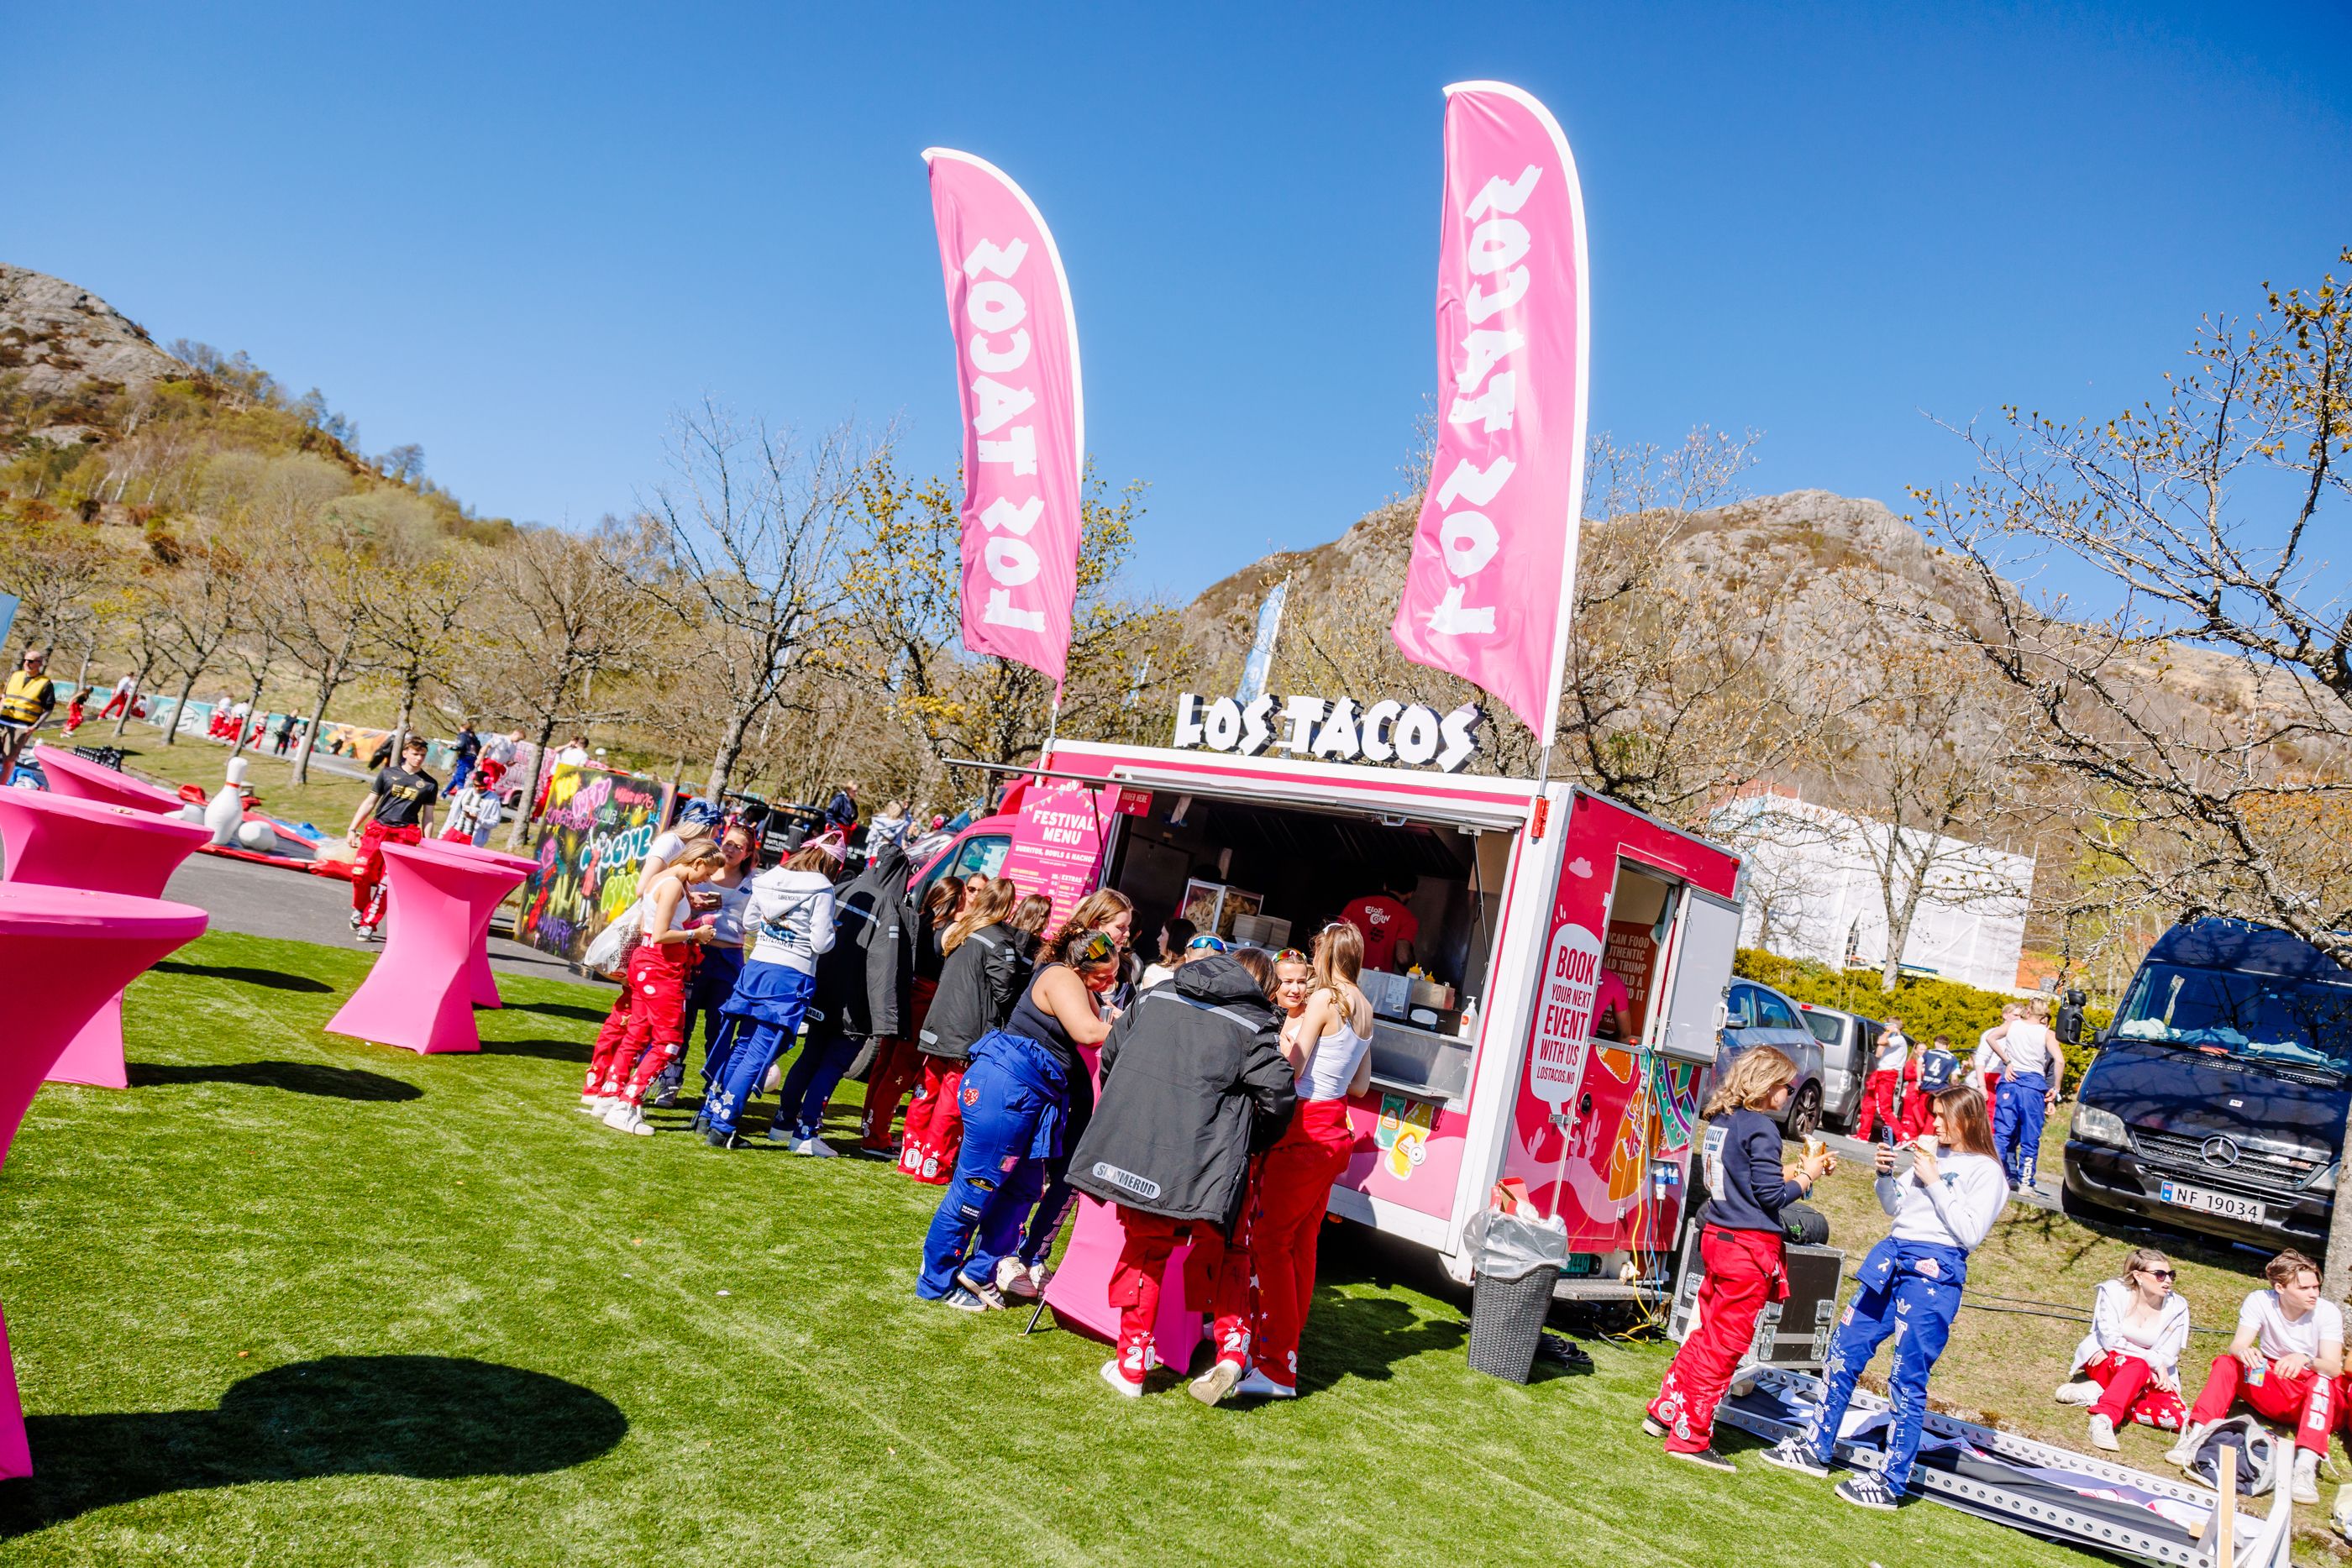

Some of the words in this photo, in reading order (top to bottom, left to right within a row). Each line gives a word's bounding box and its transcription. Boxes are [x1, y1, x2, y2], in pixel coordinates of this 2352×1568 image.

[1174, 691, 1282, 757] LOS
[1287, 695, 1487, 774] TACOS
[1032, 810, 1095, 831] FESTIVAL
[1042, 826, 1082, 845] MENU
[1015, 845, 1044, 856] BURRITOS,
[1044, 849, 1065, 858] BOWLS
[1071, 854, 1096, 863] NACHOS
[1061, 874, 1083, 884] EXTRAS
[1628, 935, 1650, 949] FOOD
[1555, 945, 1598, 986] BOOK
[1619, 959, 1647, 974] TRUMP
[1551, 983, 1572, 1005] YOUR
[1572, 988, 1592, 1009] NEXT
[1635, 989, 1646, 1001] IT
[1543, 1004, 1588, 1041] EVENT
[1539, 1038, 1567, 1064] WITH
[1566, 1043, 1580, 1067] US
[1536, 1066, 1575, 1085] LOSTACOS.NO
[1929, 1057, 1941, 1077] 4
[2176, 1188, 2198, 1204] NF
[2207, 1195, 2259, 1219] 19034
[1124, 1345, 1156, 1371] 20
